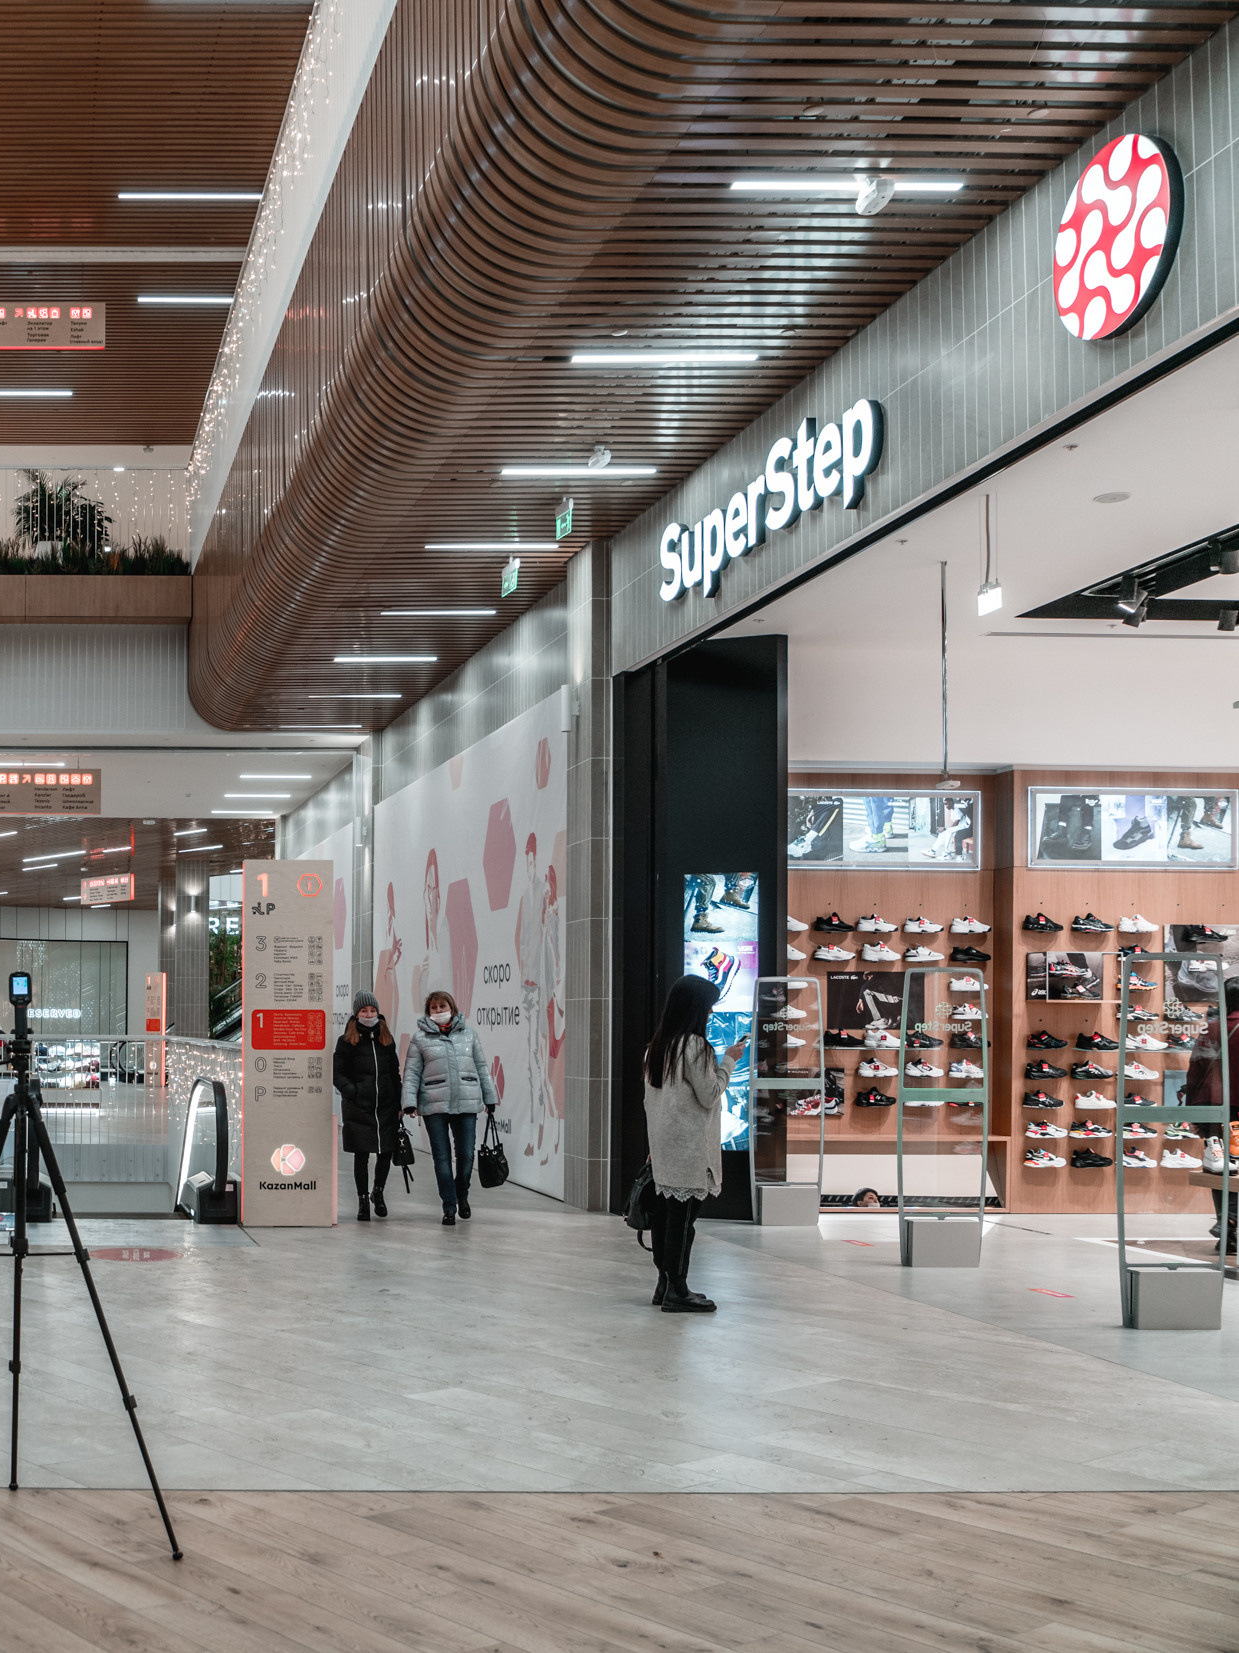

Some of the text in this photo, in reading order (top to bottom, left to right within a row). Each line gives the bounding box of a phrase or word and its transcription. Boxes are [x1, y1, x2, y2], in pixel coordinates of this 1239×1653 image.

[660, 399, 874, 602] SuperStep
[257, 873, 268, 898] 1
[256, 935, 267, 951] 3
[255, 973, 267, 988] 2
[484, 963, 510, 989] скоро
[26, 1008, 82, 1018] ESERVED
[256, 1013, 263, 1028] 1
[477, 1006, 520, 1031] открытие
[255, 1086, 266, 1102] P
[260, 1180, 316, 1190] KazanMall
